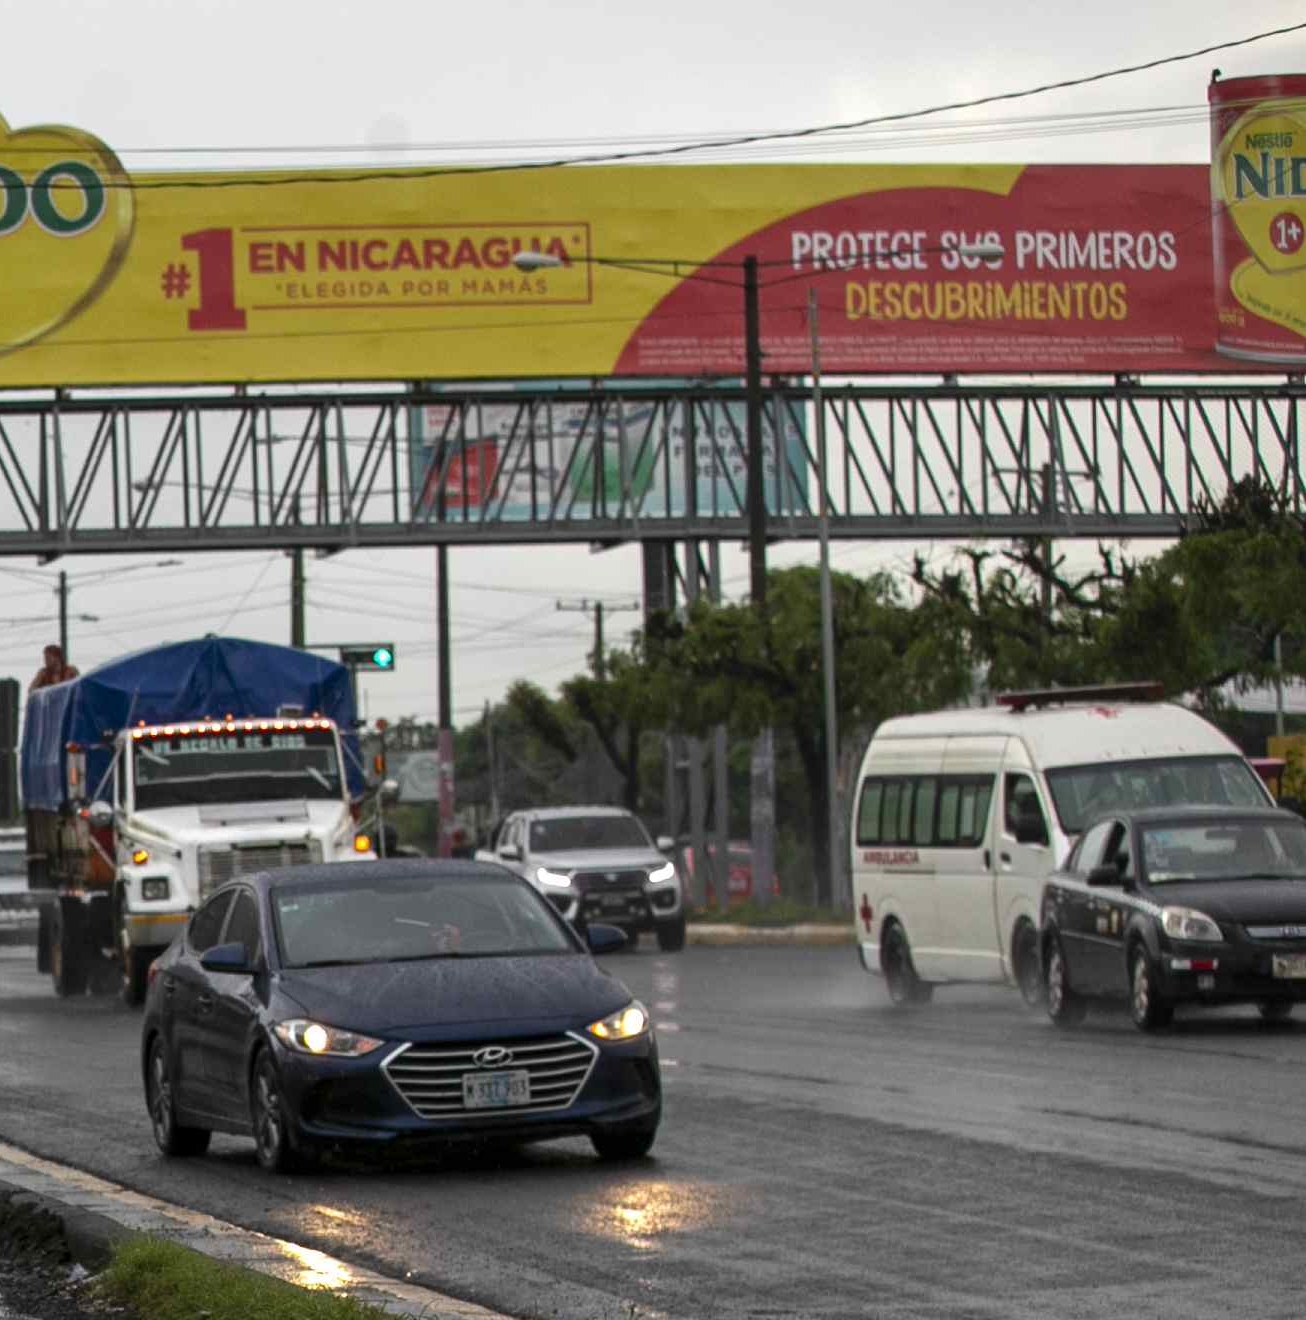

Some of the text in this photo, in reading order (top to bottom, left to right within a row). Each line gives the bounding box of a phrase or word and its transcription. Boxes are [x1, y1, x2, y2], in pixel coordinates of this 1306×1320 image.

[248, 241, 306, 274] EN
[790, 230, 1178, 271] PROTEGE SUS PRIMEROS
[401, 279, 451, 297] POR
[461, 276, 549, 296] MAMÁS
